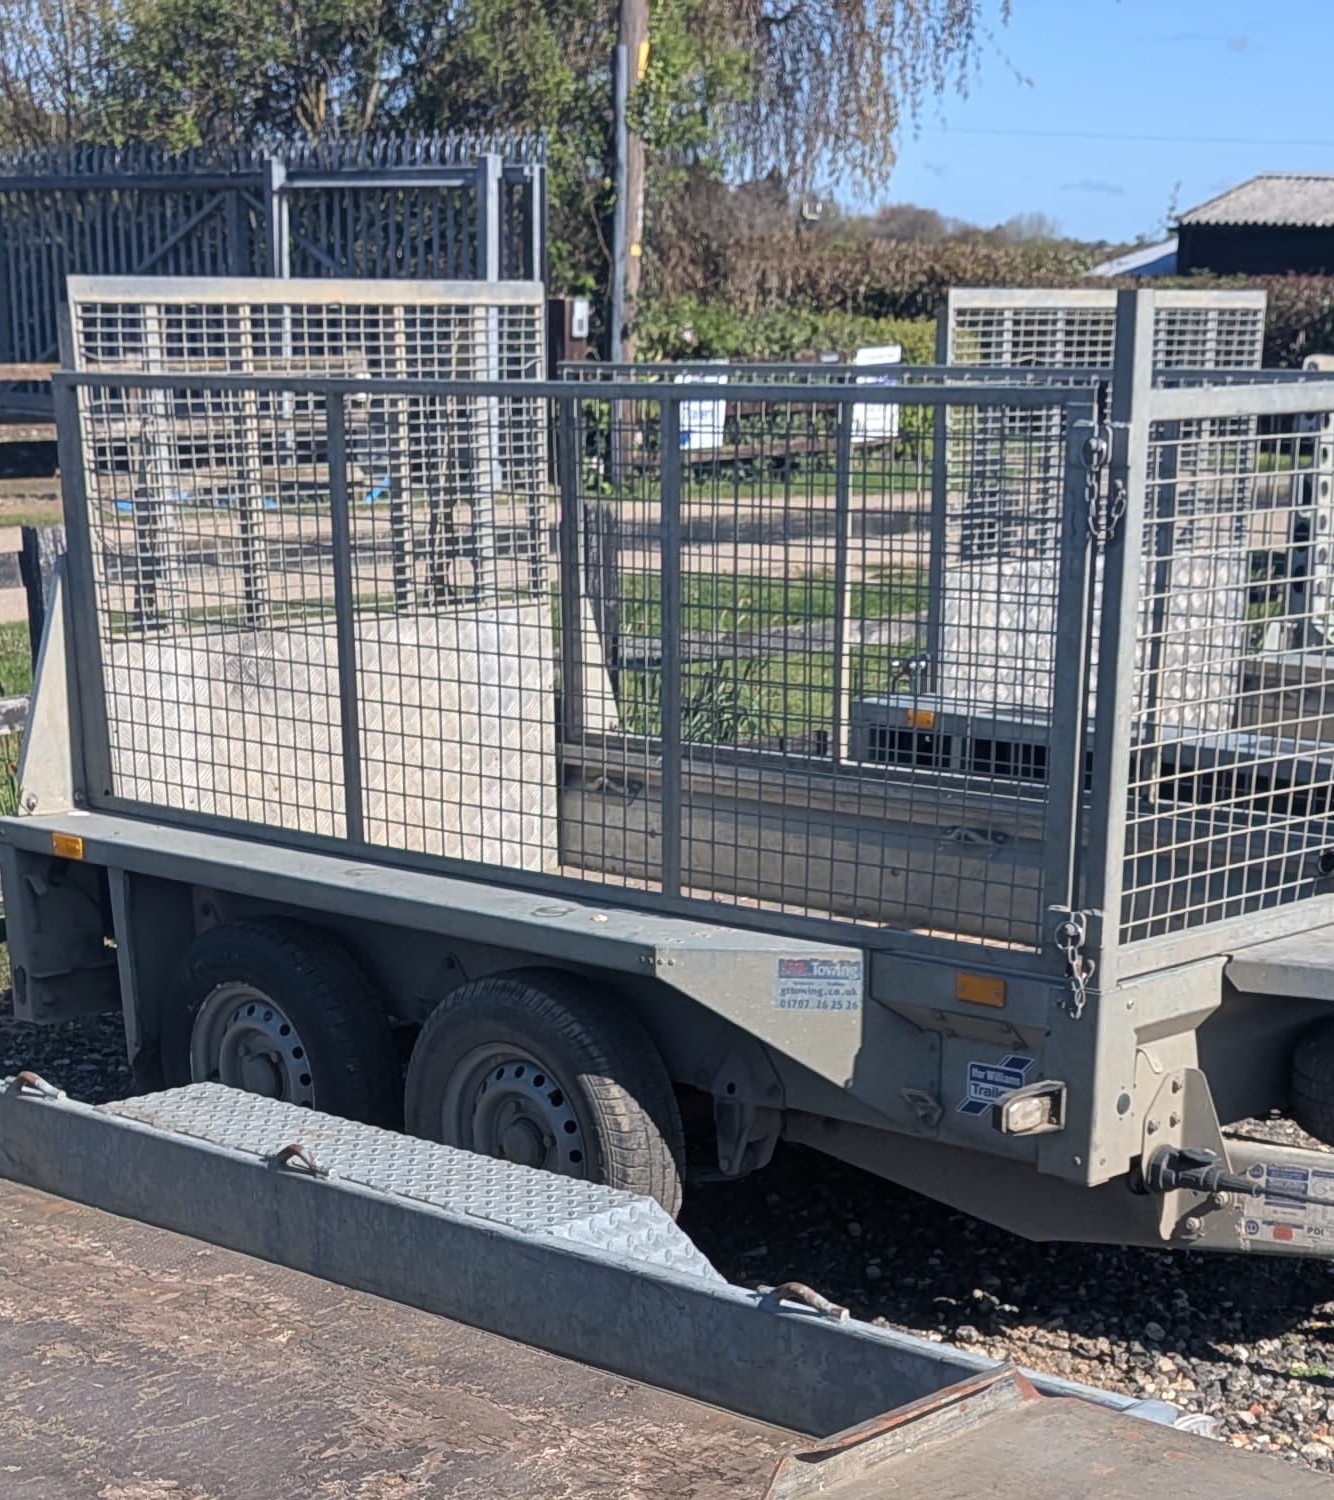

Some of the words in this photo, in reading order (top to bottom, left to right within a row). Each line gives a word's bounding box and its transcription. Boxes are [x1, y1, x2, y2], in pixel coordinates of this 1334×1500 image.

[810, 962, 859, 980] Towing
[779, 987, 858, 997] gttowing.co.uk
[779, 999, 810, 1009] 01707
[816, 1000, 828, 1009] 26
[831, 1000, 843, 1010] 25
[845, 1000, 859, 1010] 26
[986, 1070, 1021, 1086] Williams
